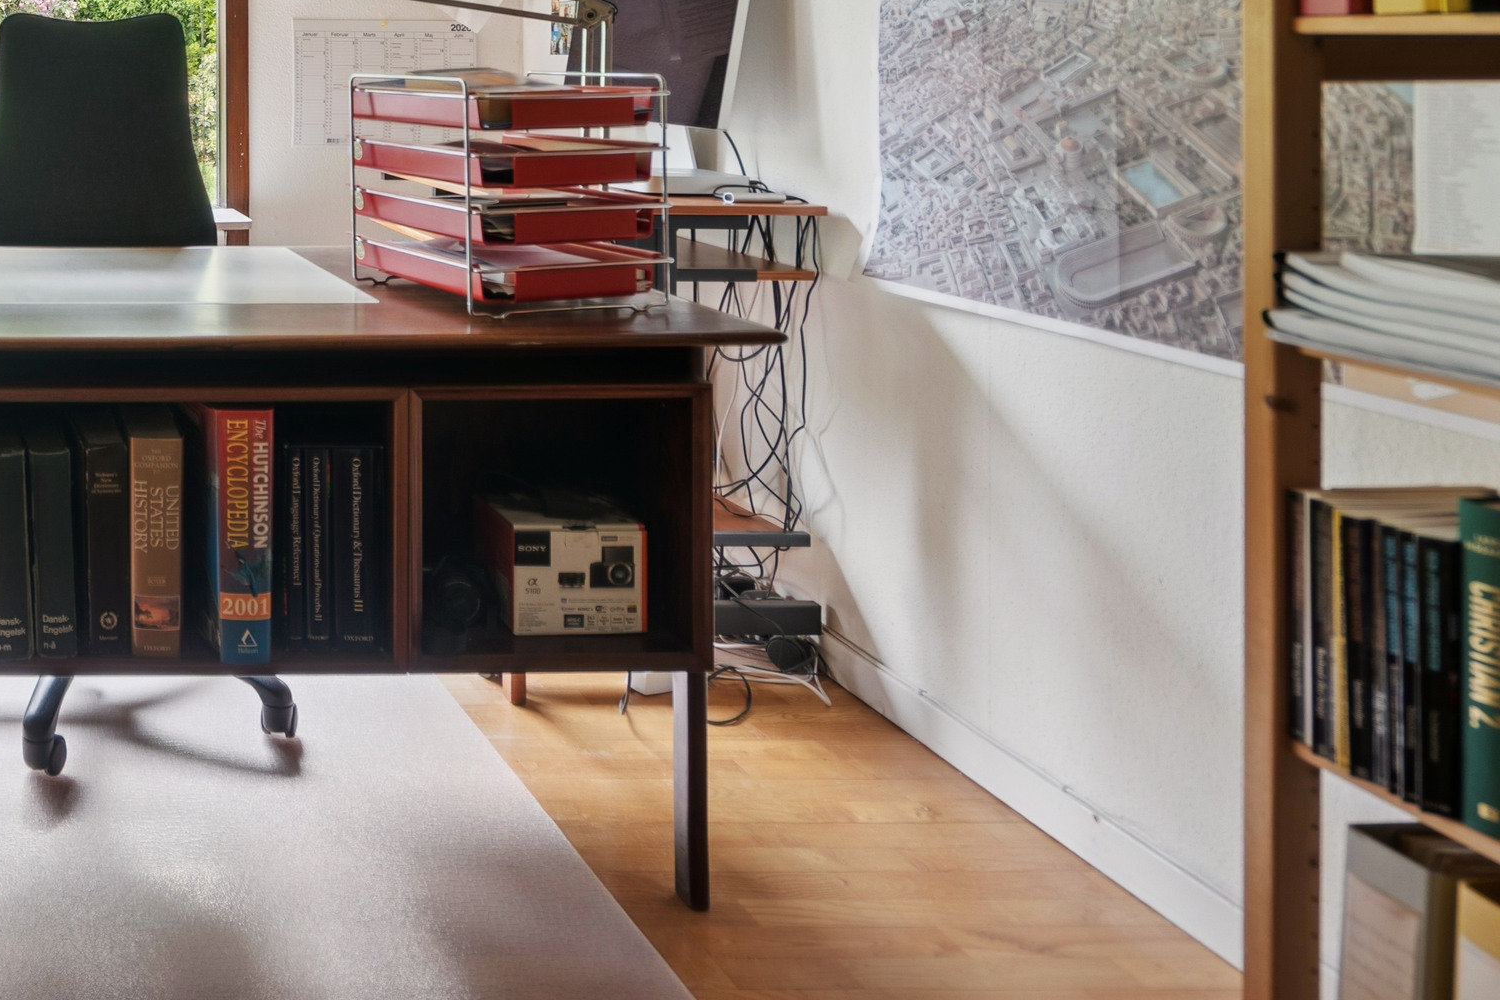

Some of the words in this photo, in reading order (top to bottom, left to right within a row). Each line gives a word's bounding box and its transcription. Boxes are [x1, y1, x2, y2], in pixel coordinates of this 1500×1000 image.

[254, 420, 267, 438] The
[134, 462, 179, 470] COMPANION
[141, 454, 172, 462] OXFORD
[291, 456, 300, 488] Oxford
[312, 456, 320, 481] Oxford
[352, 457, 361, 490] Oxford
[226, 418, 250, 550] ENCYCLOPEDIA
[252, 442, 269, 549] HUTCHINSON
[313, 482, 321, 518] Dictionary
[134, 479, 148, 554] HISTORY
[150, 486, 164, 549] STATES
[166, 485, 180, 551] UNITED
[290, 489, 301, 533] Language
[352, 491, 365, 538] Dictionary
[292, 534, 302, 580] Reference
[353, 551, 364, 598] Thesaurus
[222, 598, 269, 617] 2001
[42, 624, 74, 636] Engelsk
